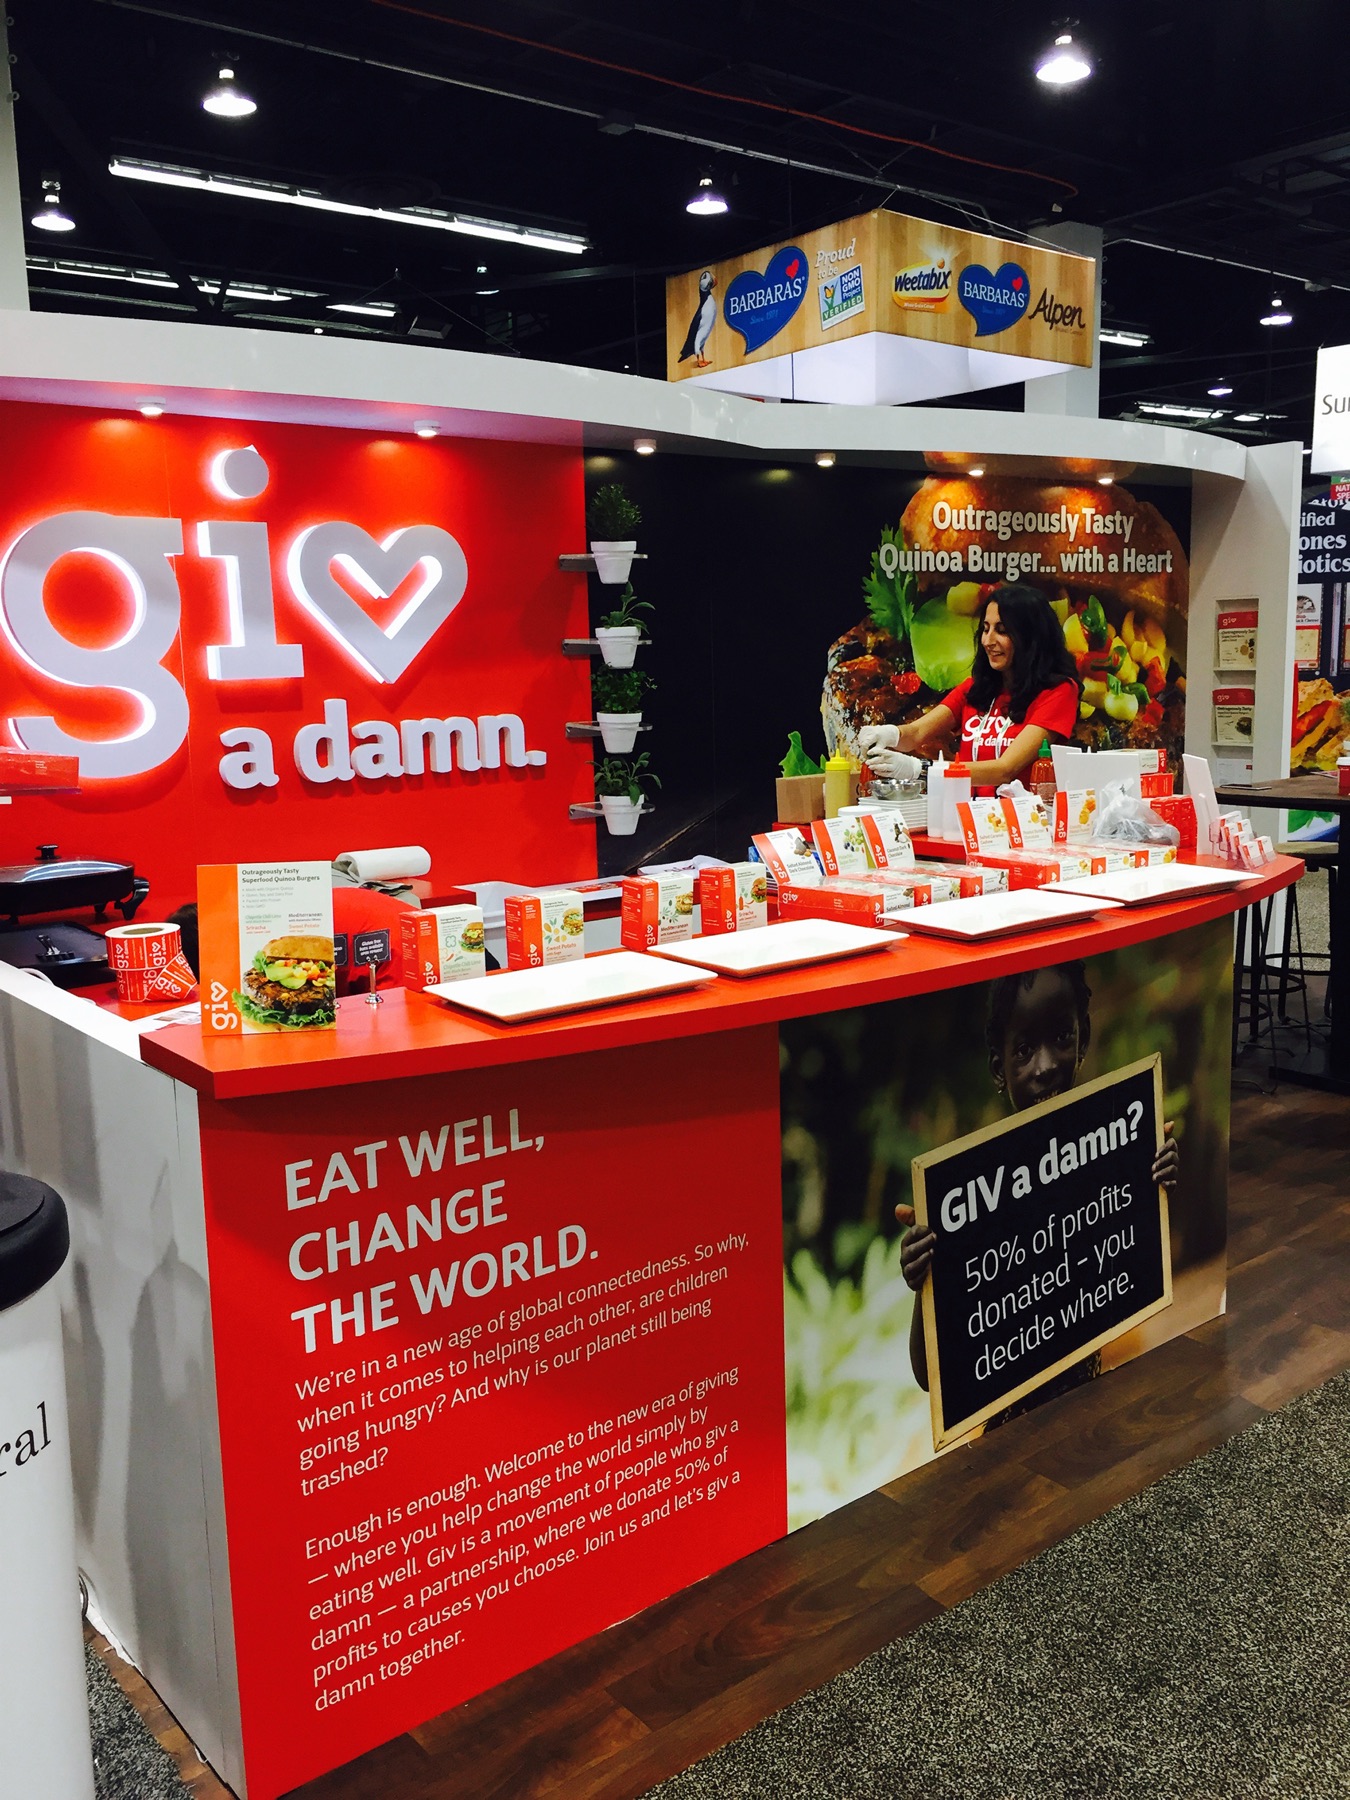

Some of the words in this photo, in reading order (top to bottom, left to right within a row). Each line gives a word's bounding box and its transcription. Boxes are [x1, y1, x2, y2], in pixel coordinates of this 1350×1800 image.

[814, 237, 857, 268] Proud
[828, 265, 839, 277] be
[841, 268, 860, 284] NON
[842, 277, 861, 292] GMO
[843, 287, 861, 300] Project
[894, 267, 952, 292] Weetabix
[823, 295, 862, 319] VERIFIED
[1028, 288, 1086, 330] Alpen
[879, 543, 963, 580] Quinoa
[968, 545, 1057, 581] Burger...
[1060, 549, 1104, 573] with
[1107, 555, 1119, 573] a
[1123, 549, 1173, 573] Heart
[932, 501, 1080, 542] Outrageously
[1082, 507, 1134, 543] Tasty
[1299, 511, 1336, 527] ified
[219, 726, 280, 790] a
[294, 699, 547, 784] damn.
[284, 1141, 388, 1211] EAT
[398, 1108, 544, 1177] WELL,
[940, 1165, 1006, 1233] GIV
[1012, 1165, 1033, 1200] a
[1038, 1100, 1144, 1185] damn?
[288, 1179, 507, 1280] CHANGE
[965, 1234, 1026, 1292] 50%
[1032, 1213, 1056, 1254] of
[1061, 1183, 1133, 1249] profits
[290, 1280, 399, 1353] THE
[409, 1224, 598, 1314] WORLD.
[294, 1367, 356, 1400] We're
[361, 1359, 380, 1378] in
[385, 1353, 398, 1369] a
[403, 1336, 443, 1363] new
[447, 1324, 482, 1349] age
[487, 1309, 505, 1333] of
[509, 1290, 562, 1331] global
[567, 1253, 690, 1305] connectedness.
[694, 1244, 713, 1261] So
[716, 1232, 748, 1253] why,
[967, 1251, 1070, 1337] donated
[1093, 1224, 1135, 1274] you
[974, 1314, 1054, 1380] decide
[1059, 1271, 1134, 1328] where.
[296, 1400, 355, 1432] when
[360, 1390, 374, 1410] it
[378, 1367, 444, 1402] comes
[447, 1359, 467, 1377] to
[472, 1332, 540, 1369] helping
[544, 1314, 584, 1342] each
[588, 1299, 635, 1326] other,
[639, 1288, 664, 1308] are
[668, 1266, 727, 1297] children
[299, 1429, 360, 1470] going
[365, 1393, 446, 1440] hungry?
[450, 1375, 489, 1408] And
[493, 1365, 530, 1390] why
[534, 1359, 548, 1375] is
[552, 1345, 582, 1368] our
[586, 1323, 637, 1361] planet
[640, 1310, 667, 1335] still
[671, 1298, 711, 1324] being
[300, 1446, 388, 1496] trashed?
[305, 1512, 382, 1559] Enough
[386, 1507, 402, 1525] is
[406, 1473, 480, 1516] enough.
[484, 1439, 564, 1482] Welcome
[567, 1431, 584, 1448] to
[586, 1419, 613, 1440] the
[616, 1403, 648, 1428] new
[651, 1393, 675, 1413] era
[678, 1380, 693, 1401] of
[695, 1366, 738, 1400] giving
[333, 1540, 396, 1577] where
[400, 1522, 437, 1555] you
[442, 1503, 482, 1532] help
[486, 1473, 551, 1511] change
[554, 1460, 582, 1482] the
[585, 1433, 631, 1468] world
[635, 1414, 686, 1448] simply
[690, 1405, 708, 1425] by
[309, 1579, 374, 1620] eating
[377, 1556, 421, 1589] well.
[426, 1543, 456, 1567] Giv
[461, 1535, 475, 1553] is
[480, 1529, 491, 1544] a
[496, 1482, 591, 1537] movement
[594, 1470, 611, 1493] of
[614, 1450, 666, 1490] people
[669, 1435, 701, 1459] who
[705, 1423, 727, 1448] giv
[730, 1419, 739, 1432] a
[311, 1613, 371, 1650] damn
[402, 1593, 415, 1609] a
[419, 1542, 529, 1607] partnership,
[533, 1515, 585, 1548] where
[588, 1503, 612, 1523] we
[616, 1476, 671, 1511] donate
[675, 1455, 710, 1484] 50%
[713, 1444, 728, 1466] of
[313, 1640, 377, 1688] profits
[381, 1629, 402, 1648] to
[407, 1596, 471, 1636] causes
[475, 1578, 509, 1610] you
[513, 1548, 579, 1586] choose.
[583, 1529, 615, 1555] Join
[618, 1518, 637, 1537] us
[641, 1498, 670, 1527] and
[674, 1487, 703, 1511] let's
[706, 1475, 728, 1500] giv
[731, 1470, 740, 1484] a
[314, 1672, 374, 1711] damn
[378, 1629, 465, 1680] together.
